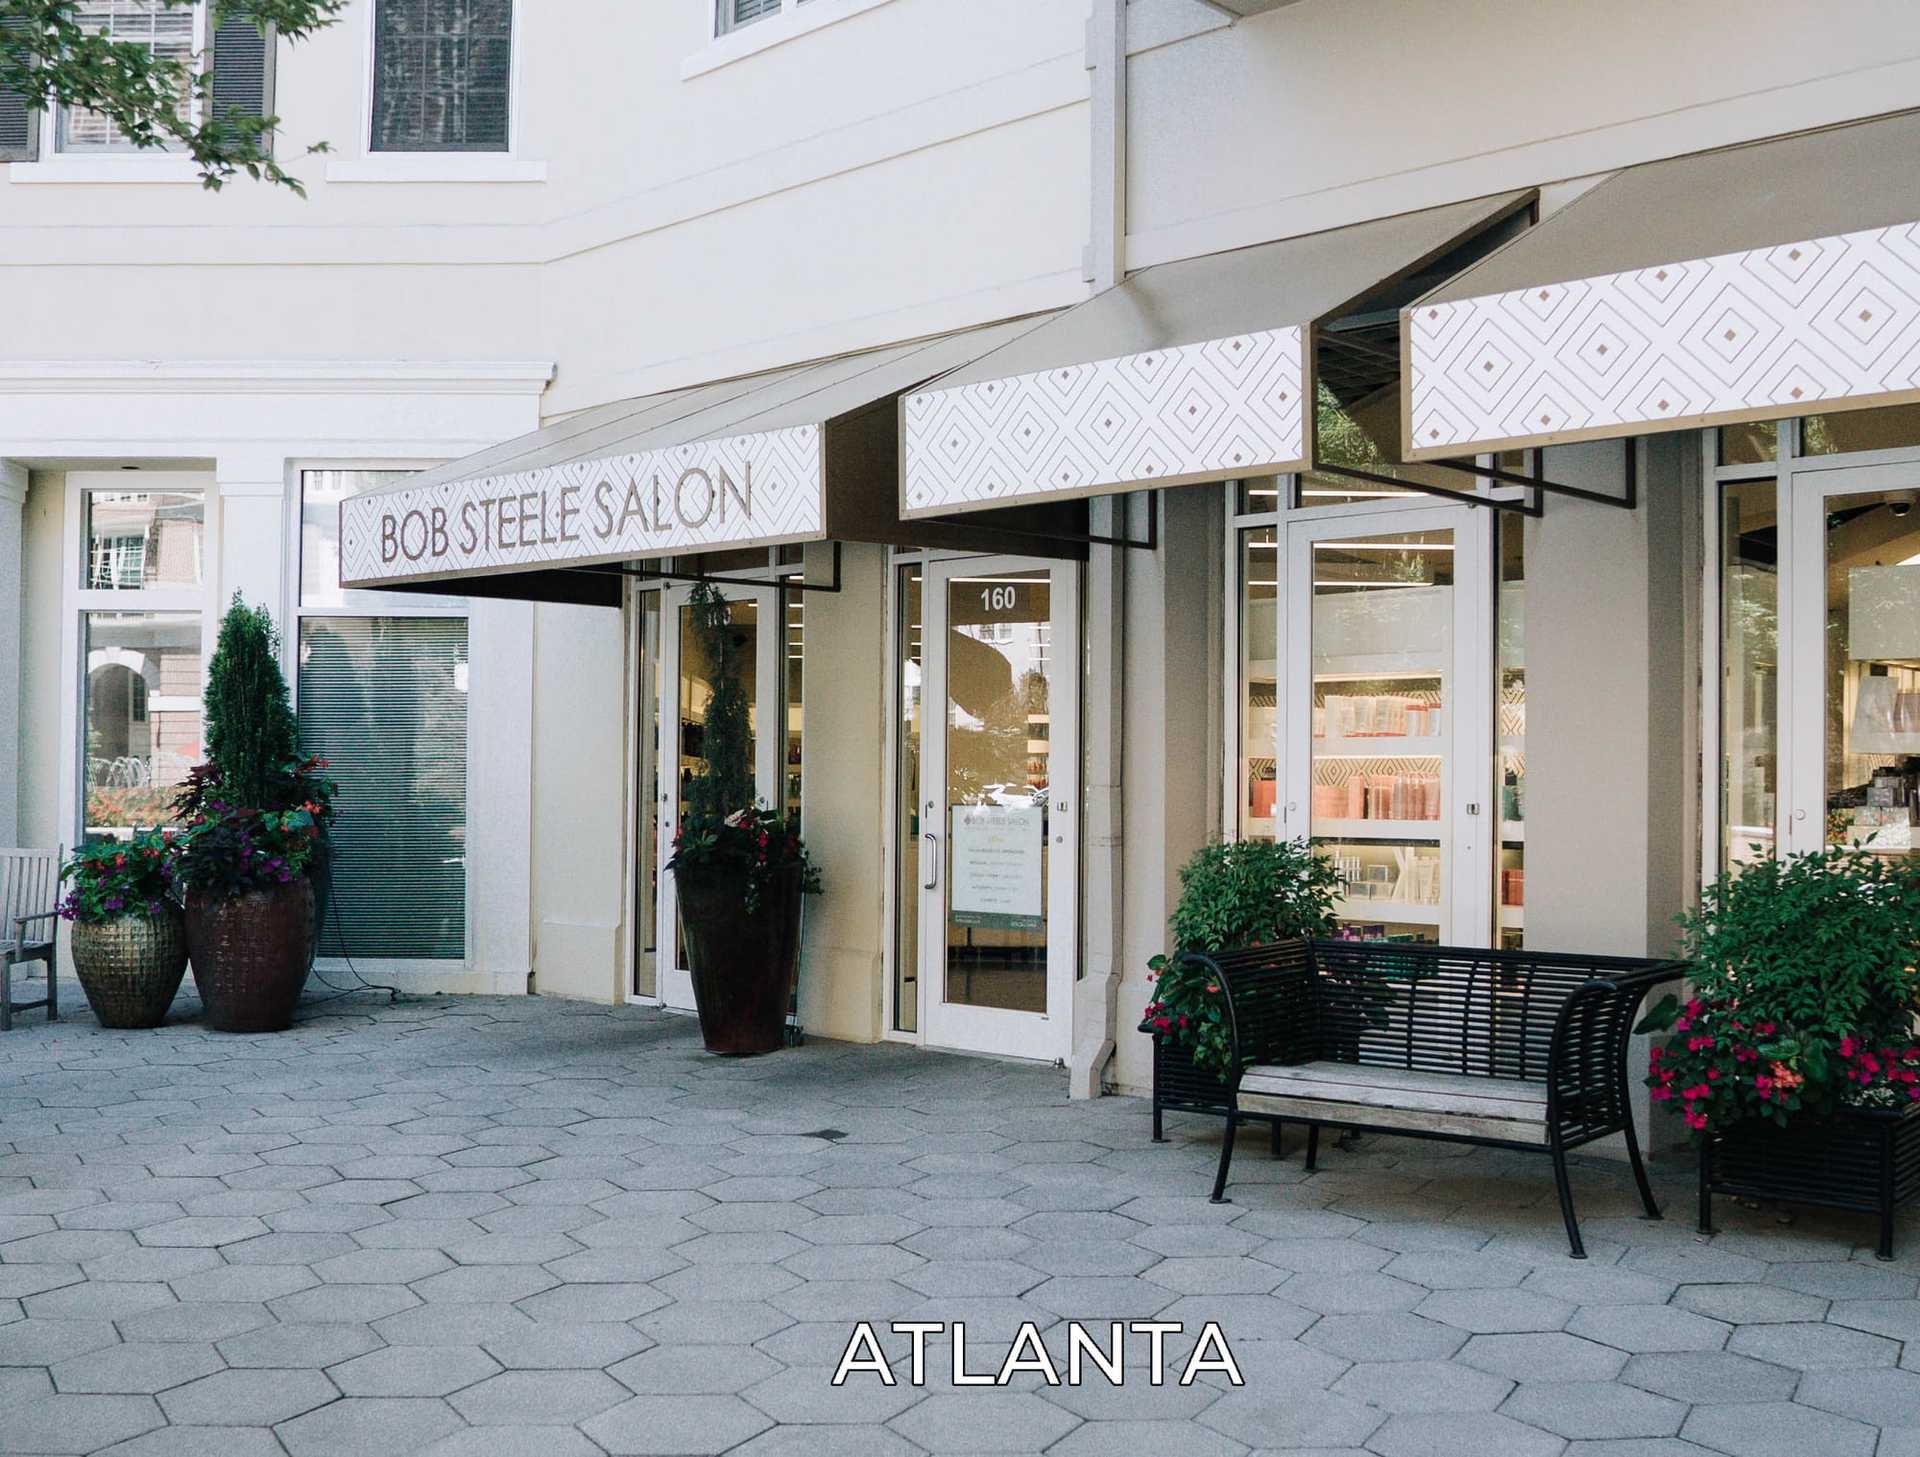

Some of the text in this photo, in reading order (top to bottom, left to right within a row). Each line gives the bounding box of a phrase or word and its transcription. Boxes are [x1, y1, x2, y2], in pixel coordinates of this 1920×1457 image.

[382, 461, 752, 562] BOB STEELE SALON
[981, 586, 1016, 611] 160
